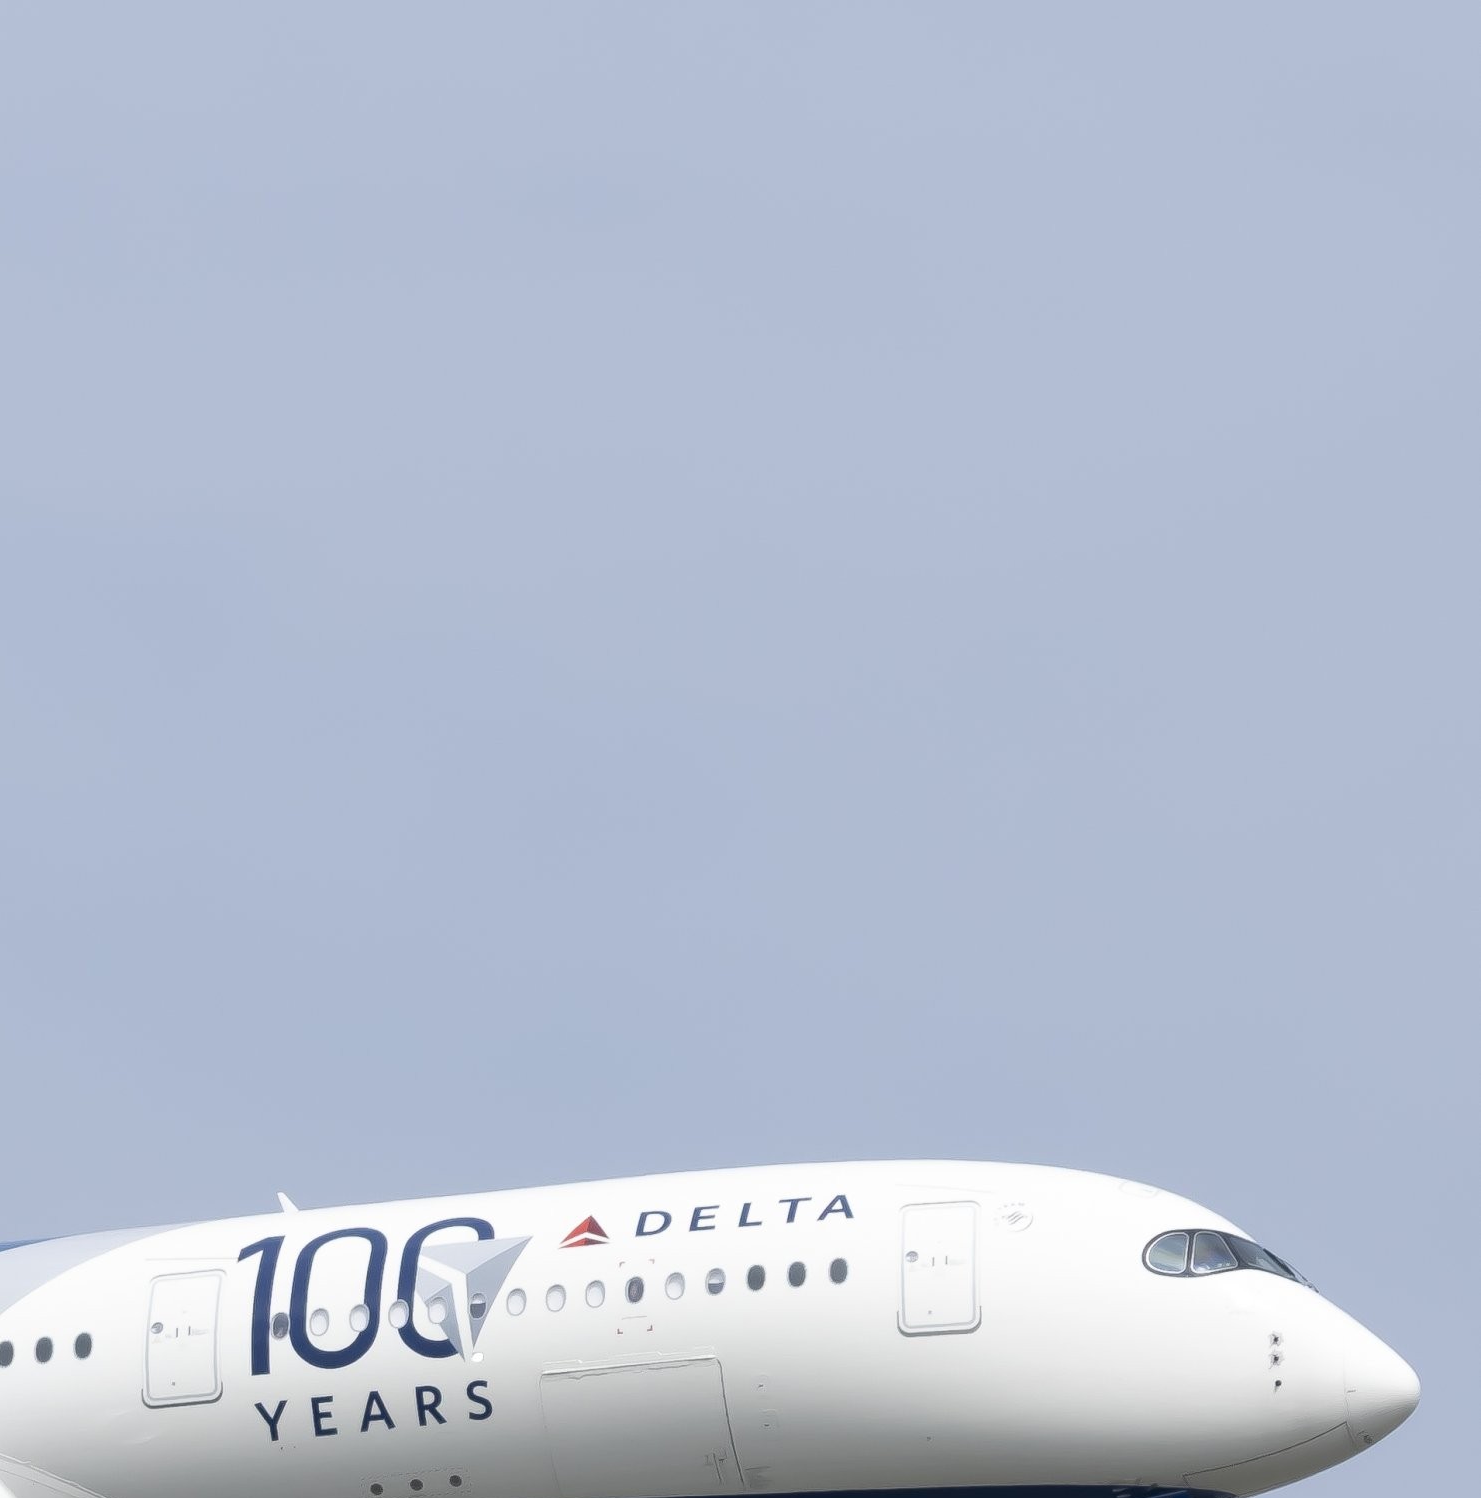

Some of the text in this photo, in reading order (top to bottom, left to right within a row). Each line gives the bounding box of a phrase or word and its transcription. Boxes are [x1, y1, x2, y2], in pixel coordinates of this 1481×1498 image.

[635, 1194, 855, 1238] DELTA
[237, 1217, 496, 1376] 100
[254, 1379, 495, 1442] YEARS
